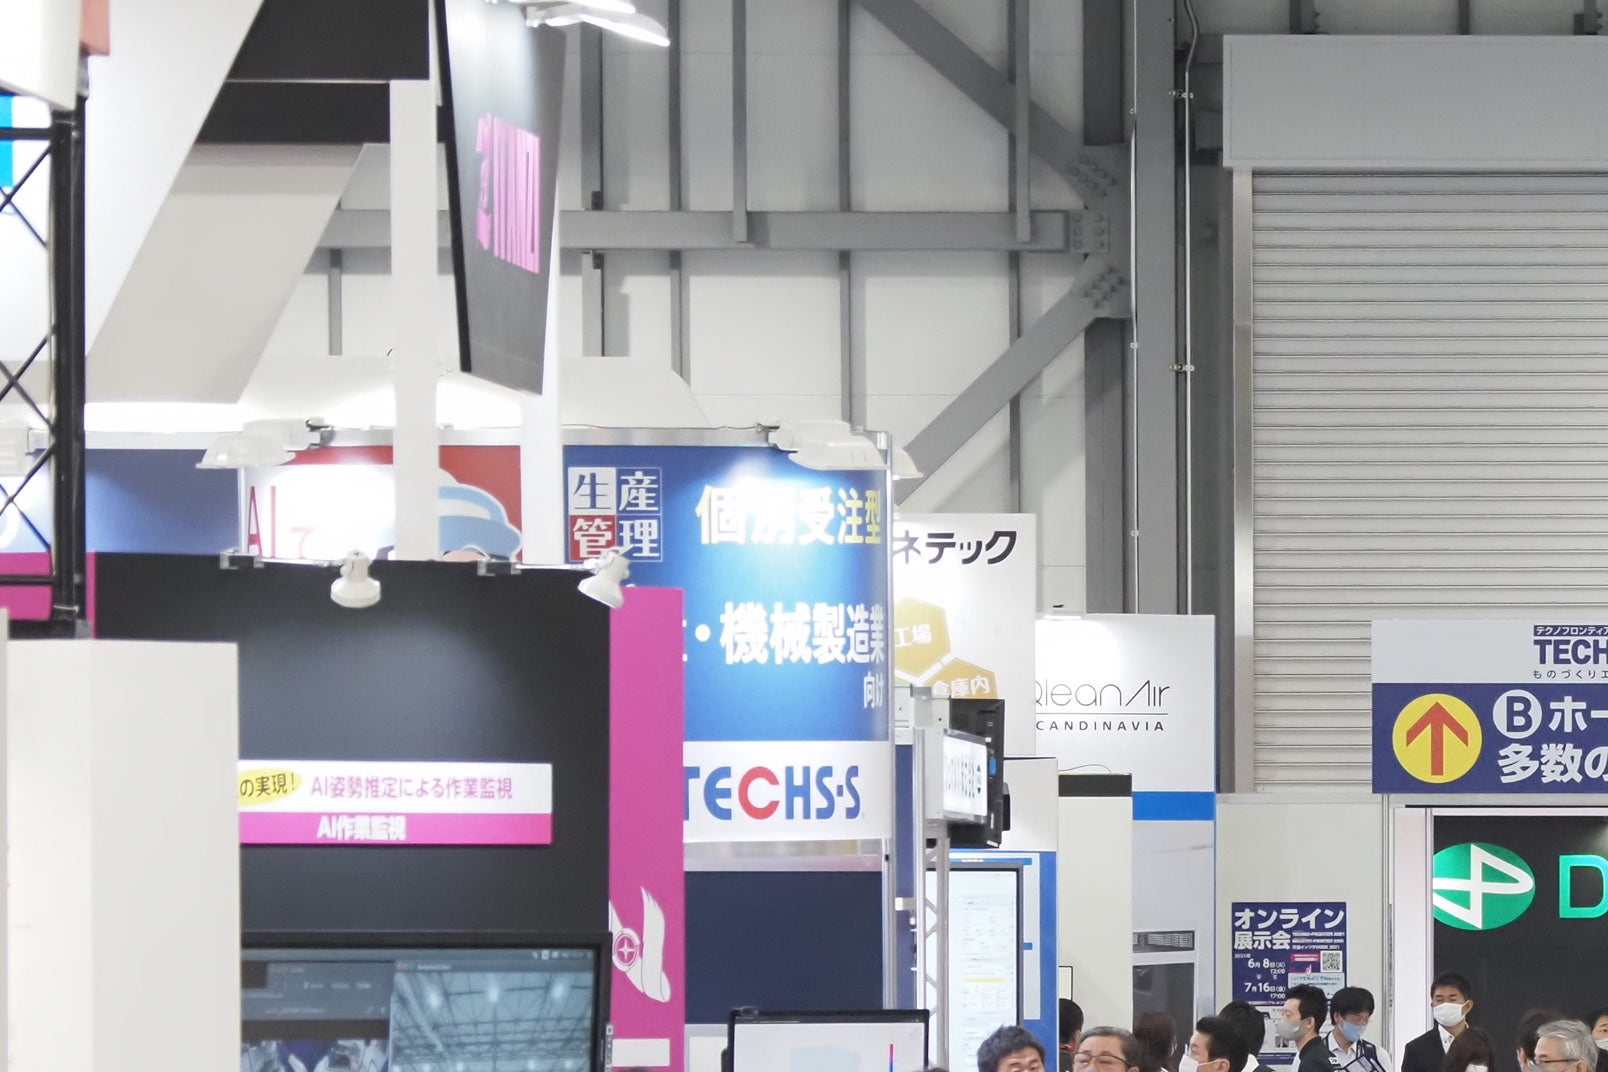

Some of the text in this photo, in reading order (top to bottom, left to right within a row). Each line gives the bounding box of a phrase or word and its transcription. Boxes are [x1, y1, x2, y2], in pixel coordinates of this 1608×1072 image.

[573, 471, 659, 512] 生産
[573, 517, 659, 557] 管理
[682, 602, 884, 665] ・機械製造業
[894, 623, 932, 648] 工場
[1036, 720, 1164, 731] CANDINAVIA
[310, 777, 512, 799] AI姿勢推定による作業監視
[317, 815, 406, 841] AI作業監視
[1234, 908, 1345, 929] オンライン
[1234, 931, 1291, 950] 展示会
